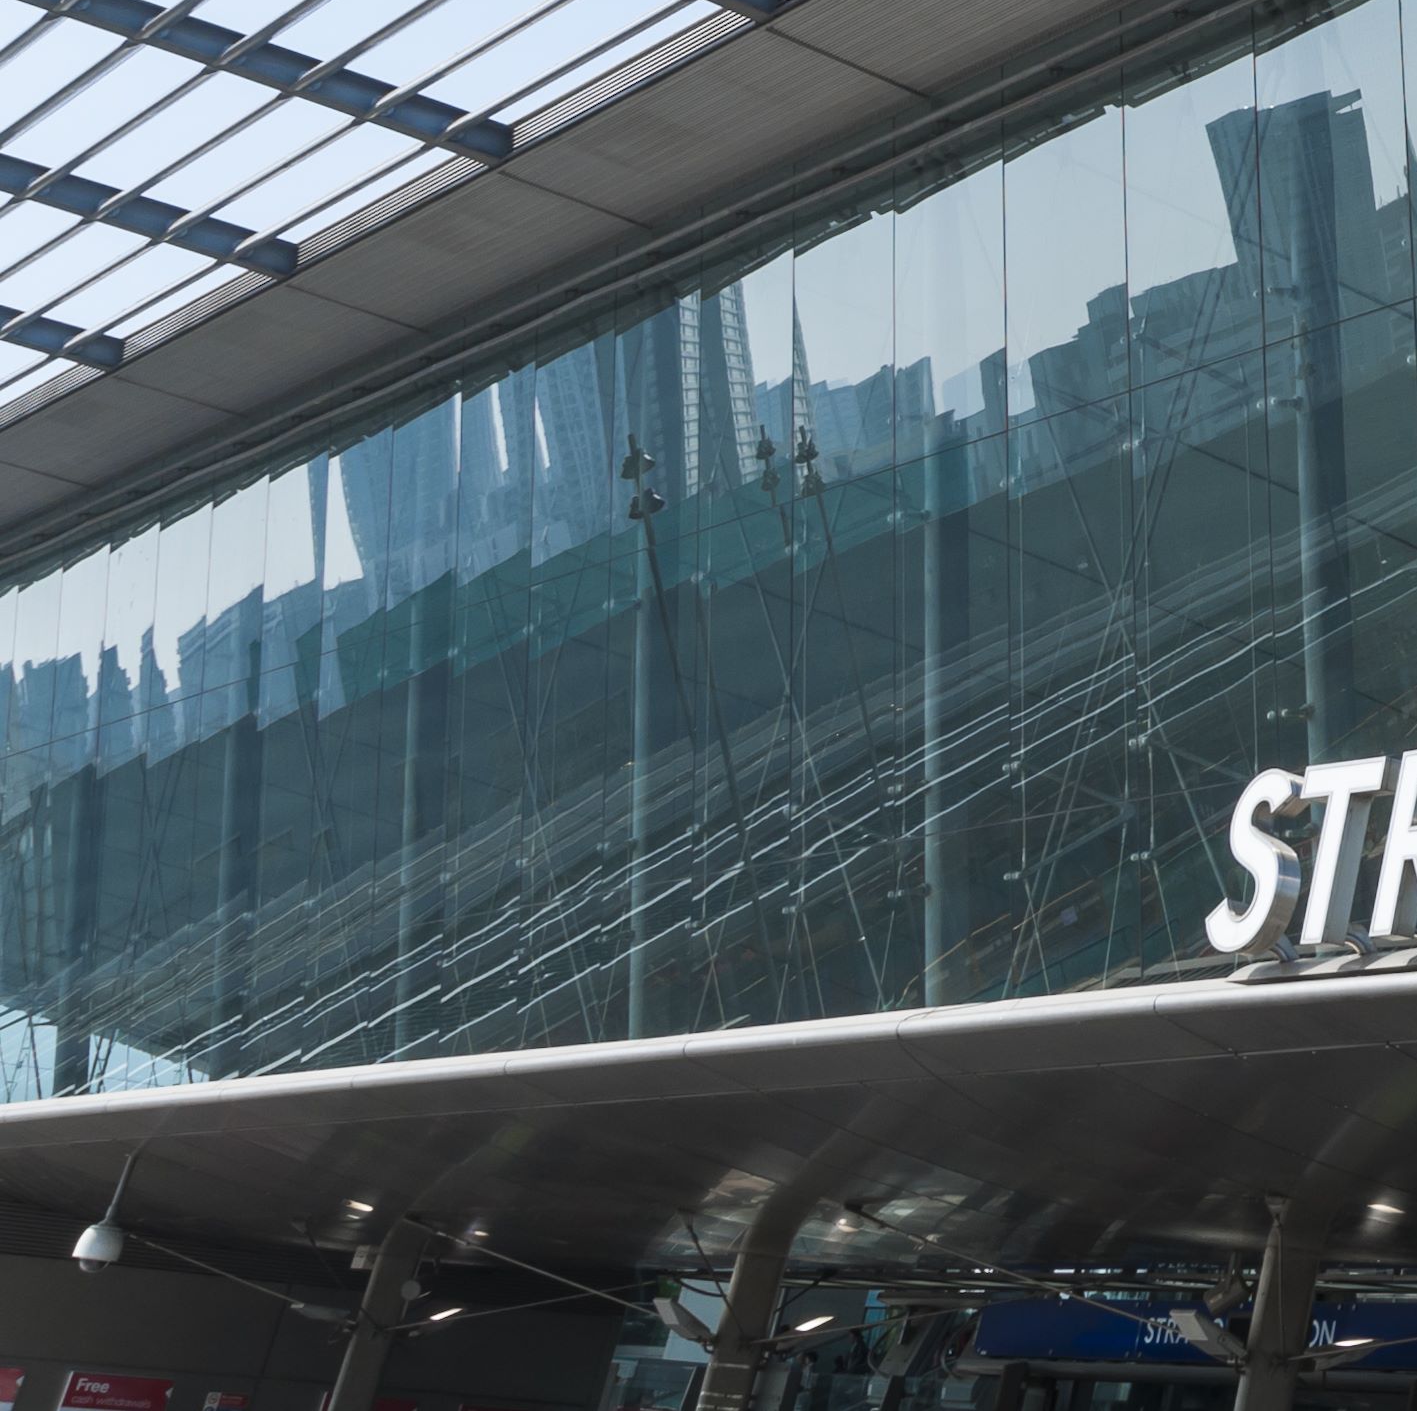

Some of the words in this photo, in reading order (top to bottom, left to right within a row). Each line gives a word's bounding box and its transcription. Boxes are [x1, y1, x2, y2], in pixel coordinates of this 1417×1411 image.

[75, 1377, 110, 1394] Free
[71, 1395, 94, 1405] cash
[95, 1397, 152, 1409] withdrawals
